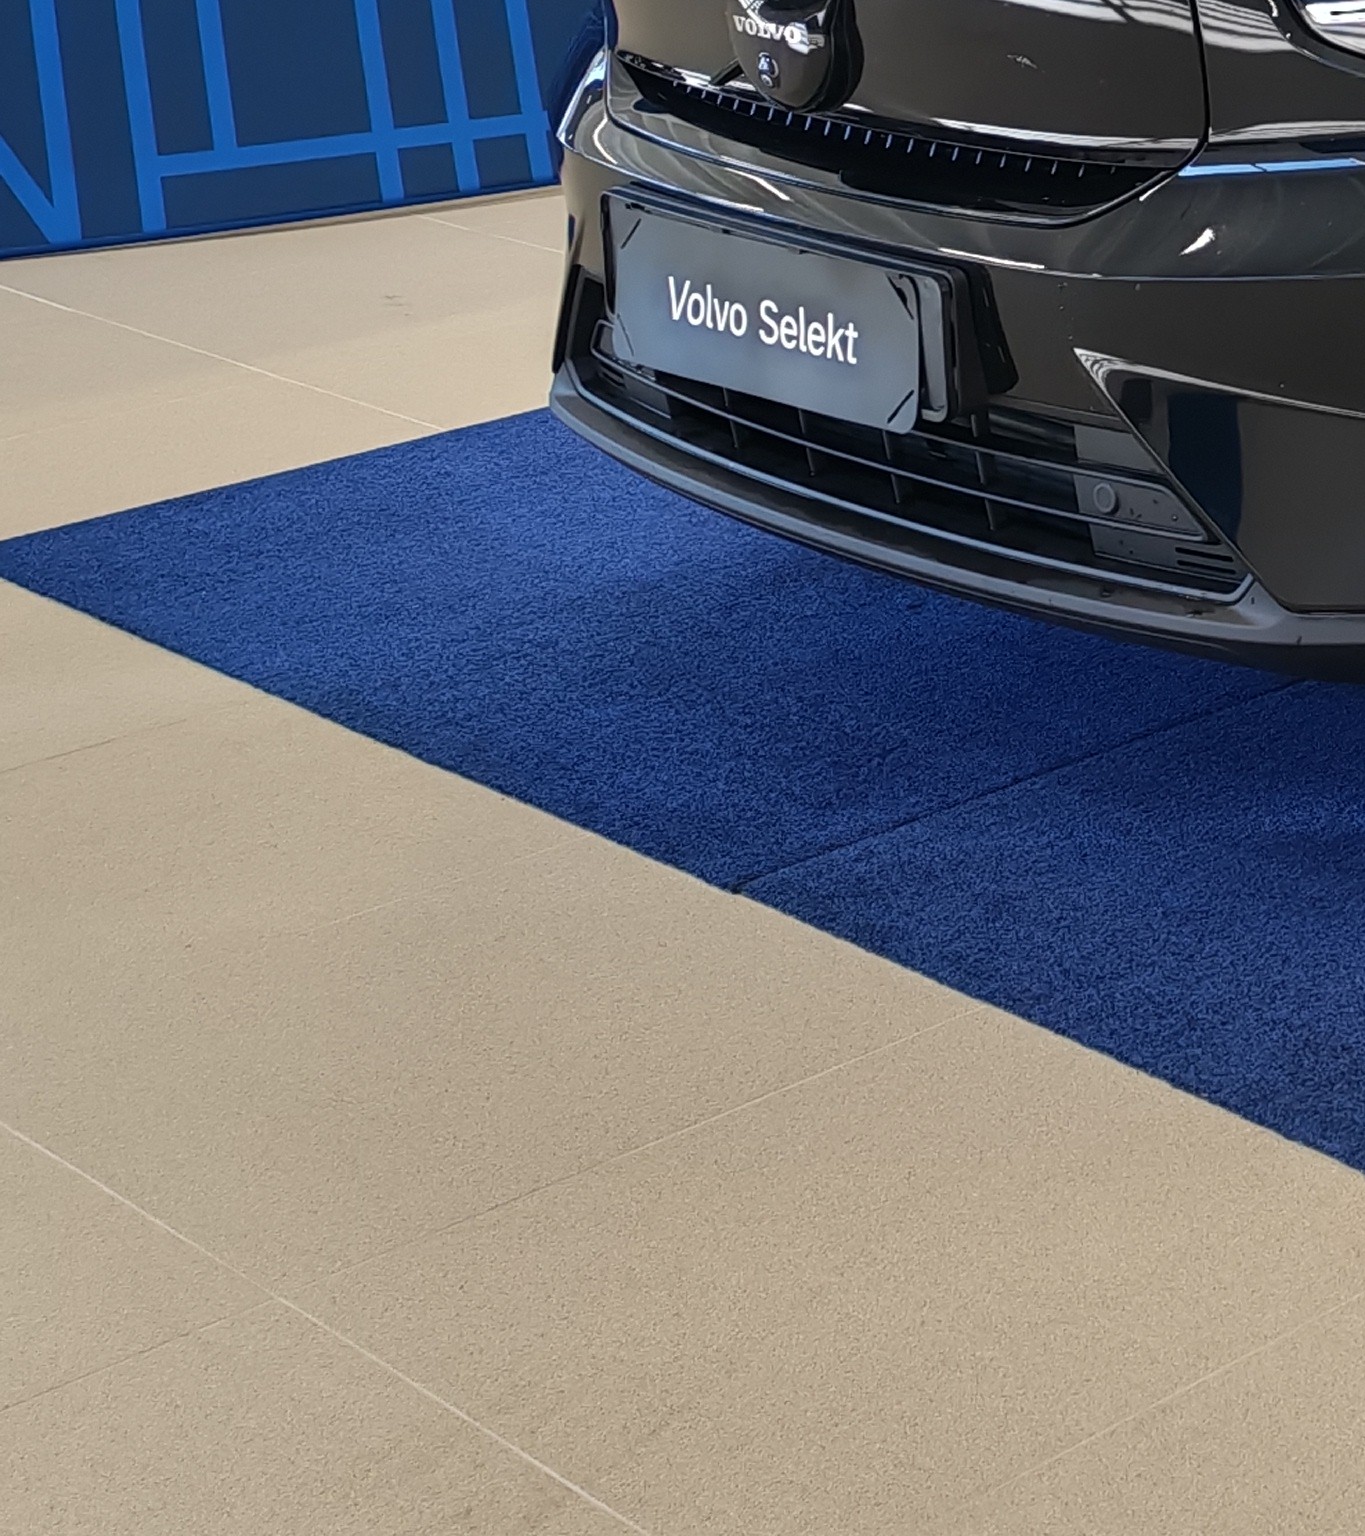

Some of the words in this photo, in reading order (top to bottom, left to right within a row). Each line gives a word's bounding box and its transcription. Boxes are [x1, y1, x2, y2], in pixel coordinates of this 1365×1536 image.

[732, 14, 801, 44] VOLVO
[668, 275, 748, 337] Volvo
[758, 299, 859, 365] Selekt
